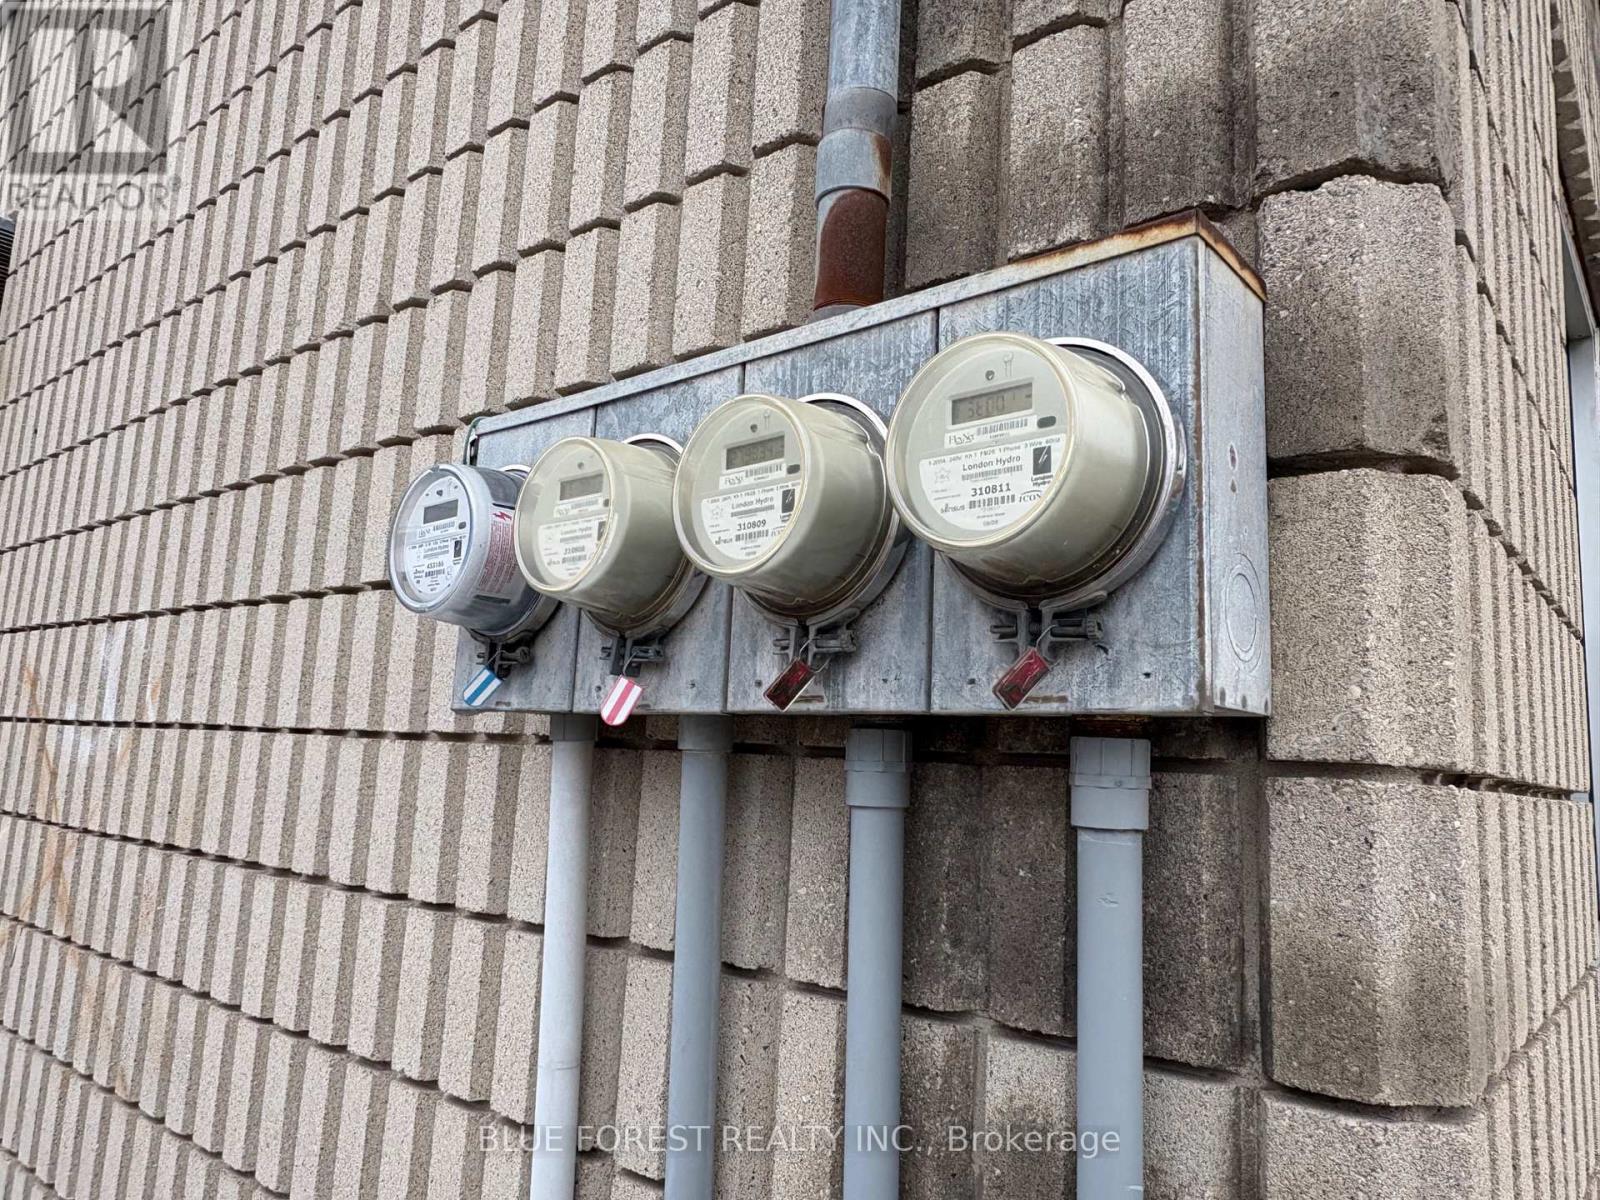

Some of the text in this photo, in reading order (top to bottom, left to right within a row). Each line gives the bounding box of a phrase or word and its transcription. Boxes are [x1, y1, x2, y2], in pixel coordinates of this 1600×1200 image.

[963, 455, 1021, 471] London Hydro
[971, 483, 1011, 497] 310811
[737, 519, 766, 531] 310809
